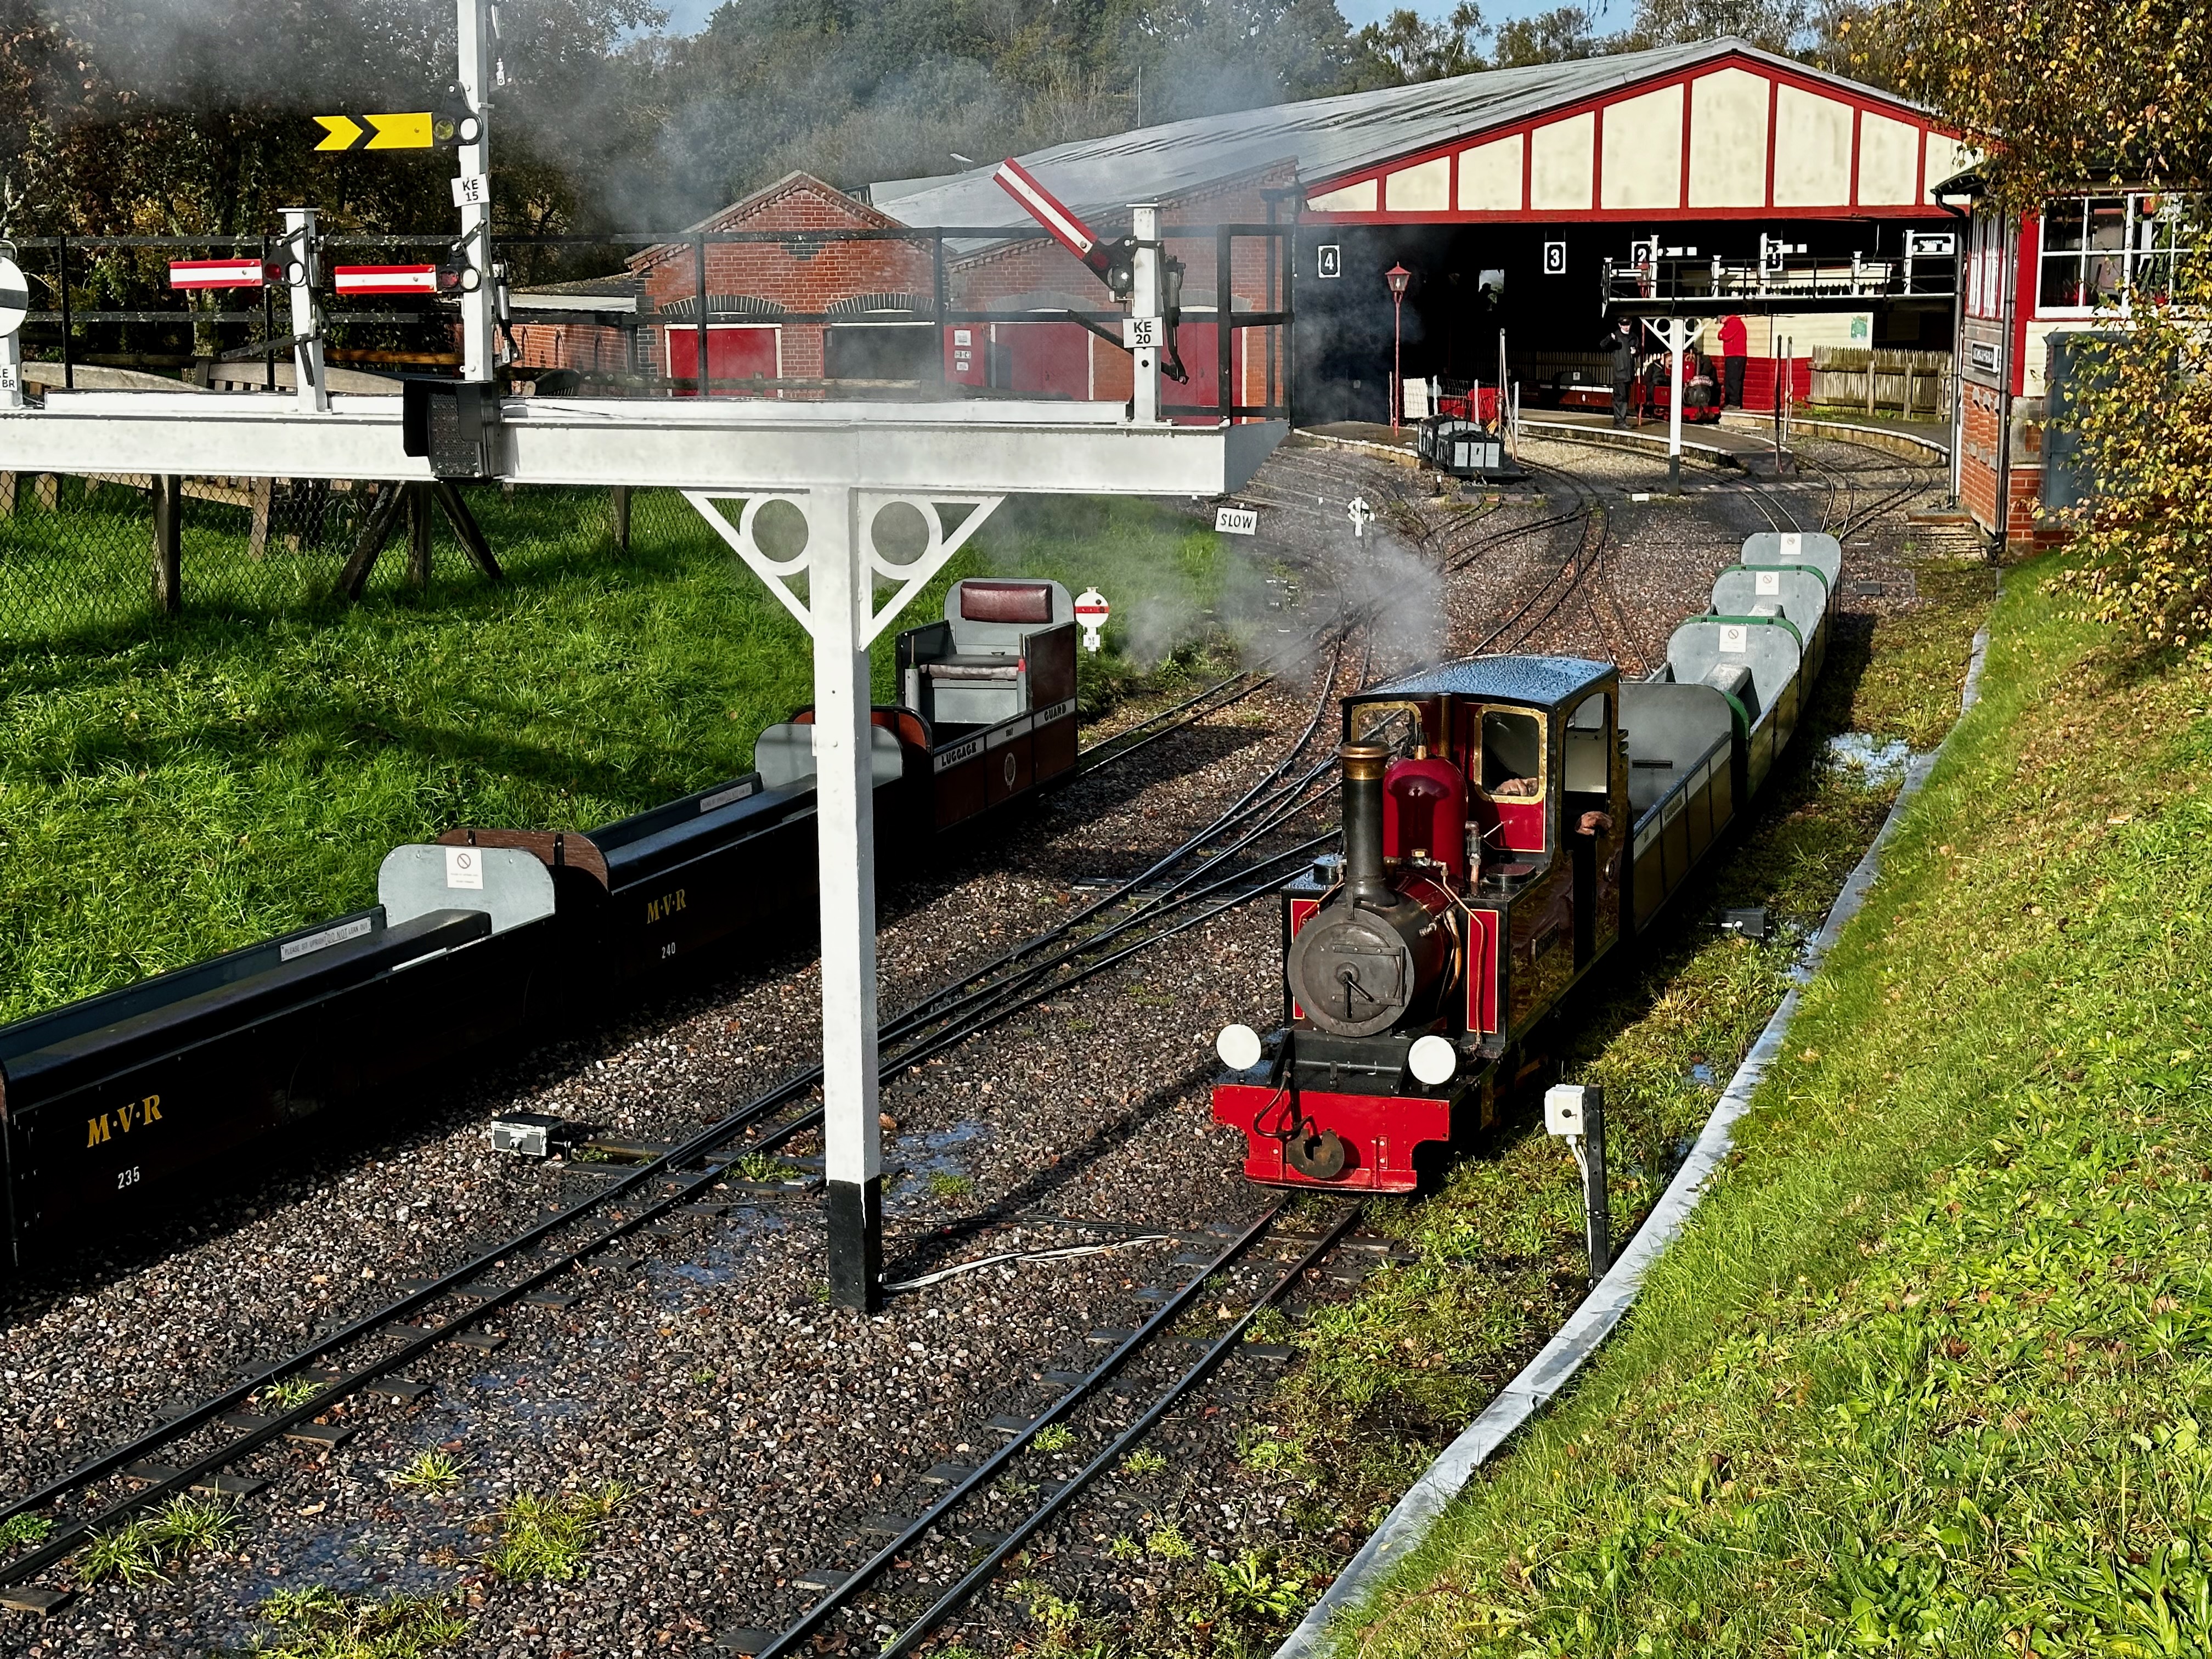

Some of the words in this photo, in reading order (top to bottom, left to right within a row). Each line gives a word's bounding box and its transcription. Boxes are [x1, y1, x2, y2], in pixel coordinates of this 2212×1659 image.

[462, 179, 478, 191] KE
[465, 191, 478, 201] 15
[1324, 252, 1334, 270] 4
[1550, 249, 1560, 267] 3
[1638, 248, 1646, 266] 2
[1133, 321, 1152, 333] KE
[1136, 334, 1151, 344] 20
[0, 368, 8, 378] E
[2, 379, 15, 388] BR
[1220, 513, 1252, 528] SLOW
[1044, 703, 1066, 721] GUARD
[941, 741, 977, 767] LUGGAGE
[285, 944, 300, 955] PLEASE
[328, 933, 335, 943] DO
[337, 928, 347, 938] NOT
[662, 942, 675, 959] 240
[118, 1166, 140, 1189] 235
